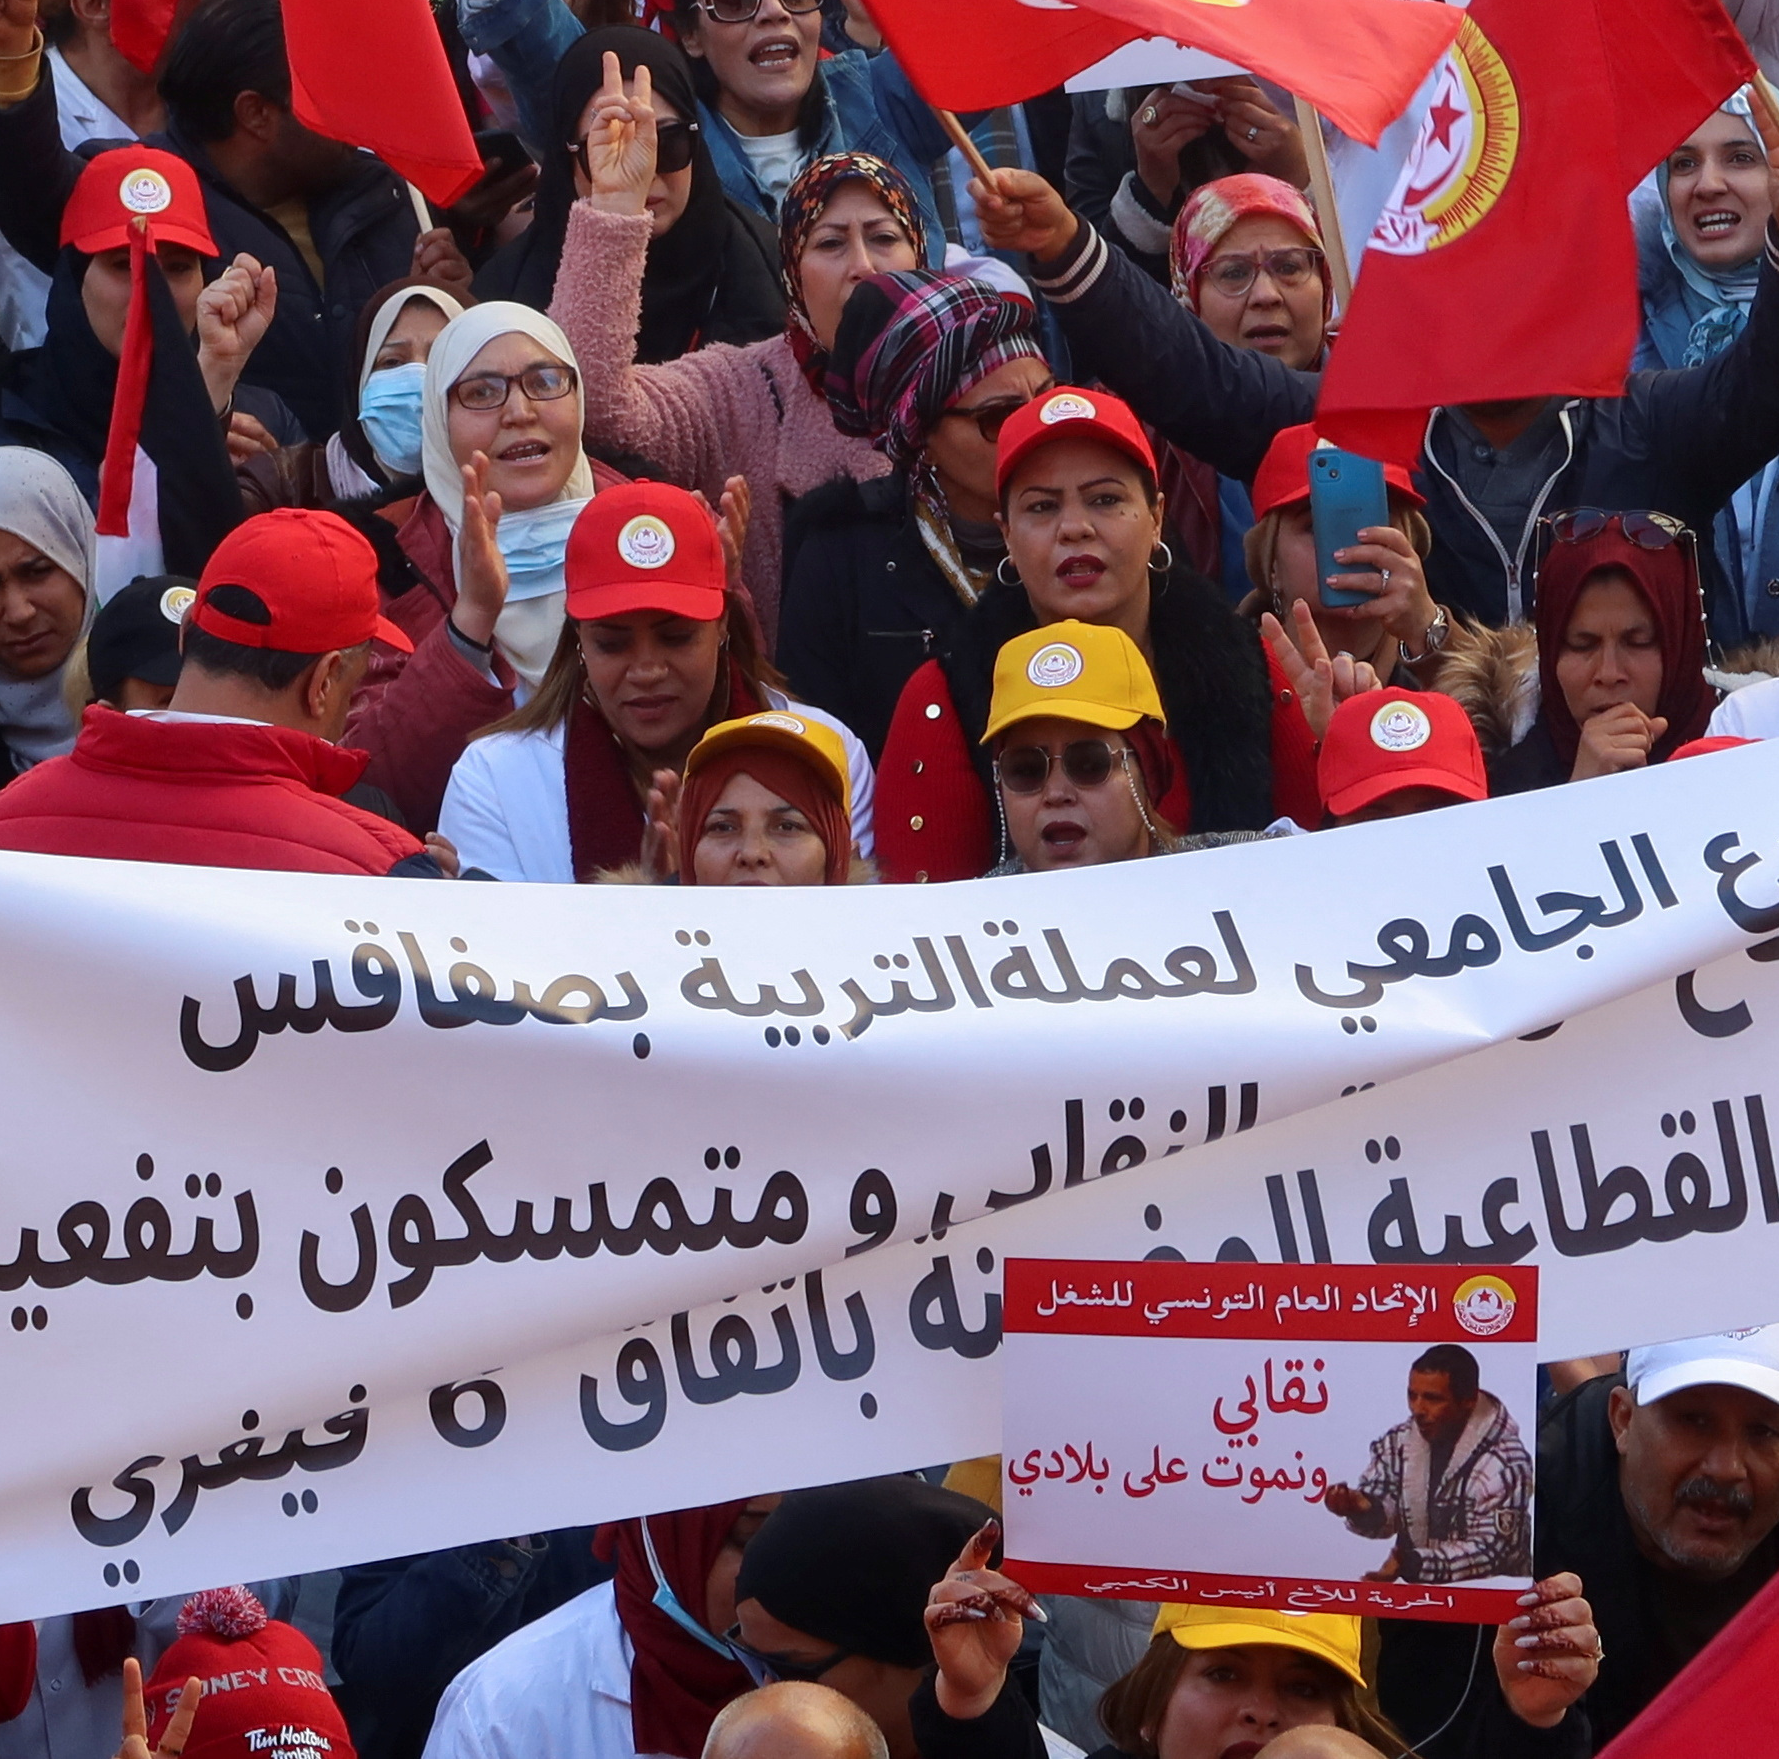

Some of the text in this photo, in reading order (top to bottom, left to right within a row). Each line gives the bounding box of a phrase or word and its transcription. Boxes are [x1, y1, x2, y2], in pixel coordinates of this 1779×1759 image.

[1294, 830, 1678, 1036] الجامعي
[179, 918, 649, 1073] بصفاقس
[299, 1137, 810, 1315] متمسكون
[1036, 1279, 1135, 1317] للشغل
[1143, 1283, 1266, 1326] التونسي
[1274, 1284, 1342, 1326] العام
[1351, 1282, 1438, 1329] الإتحاد
[1212, 1355, 1330, 1449] نقابي
[1007, 1440, 1330, 1506] ونموت على بلادي
[1083, 1574, 1190, 1596] الكعبي
[1199, 1581, 1277, 1602] أنيس
[1367, 1587, 1455, 1611] الحرية
[244, 1728, 279, 1752] Tim
